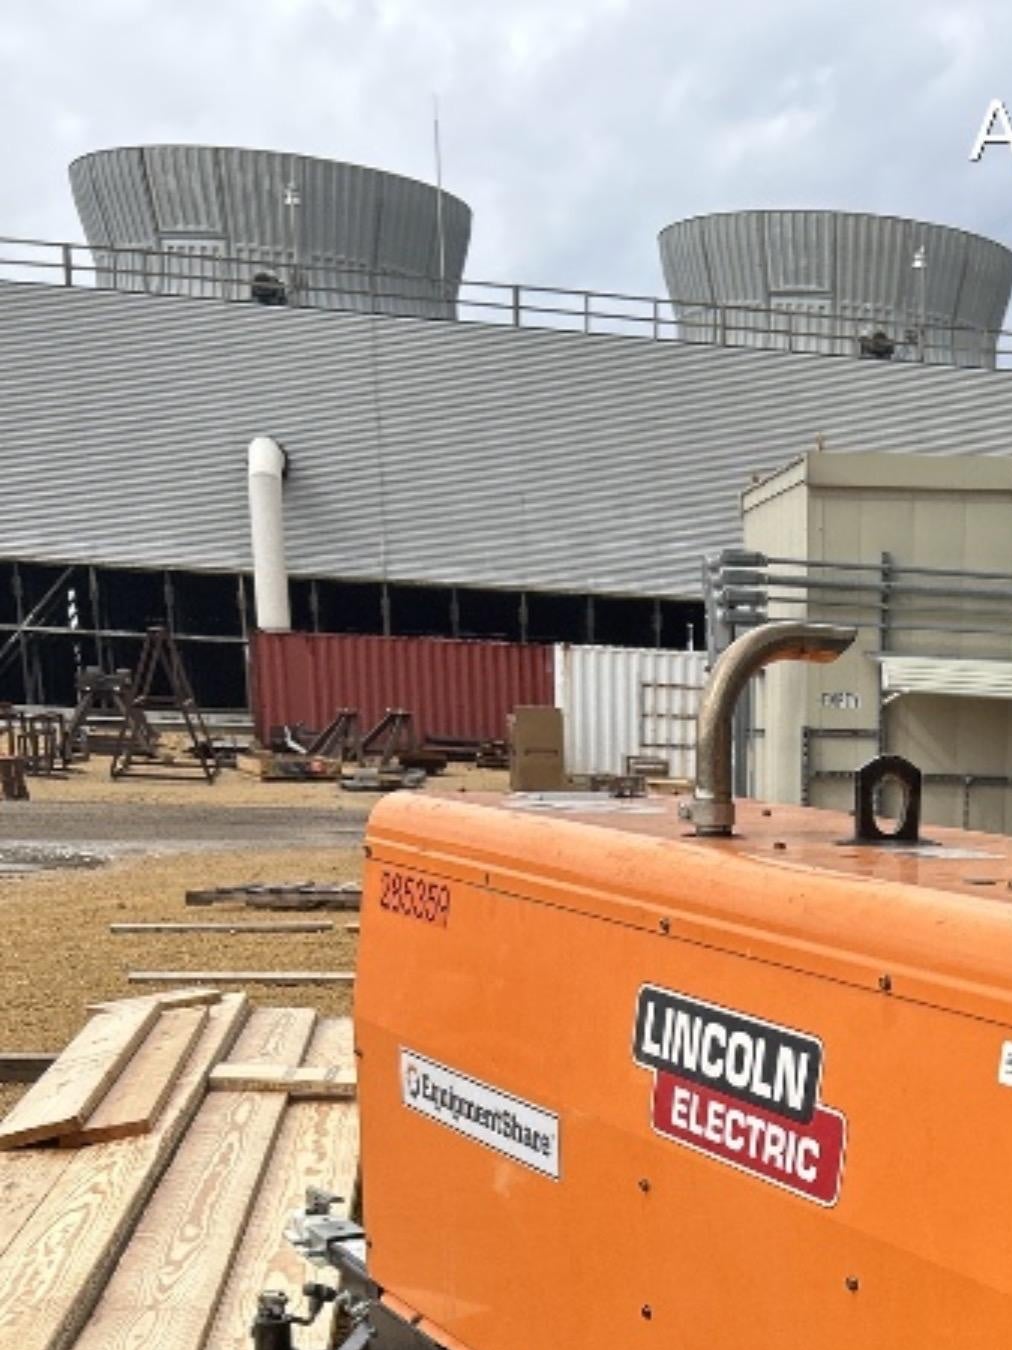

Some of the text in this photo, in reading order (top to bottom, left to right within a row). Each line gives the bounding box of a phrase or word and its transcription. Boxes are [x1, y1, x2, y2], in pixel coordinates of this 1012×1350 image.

[641, 1001, 810, 1111] LINCOLN
[422, 1073, 551, 1157] EquipmentShare
[671, 1085, 820, 1183] ELECTRIC
